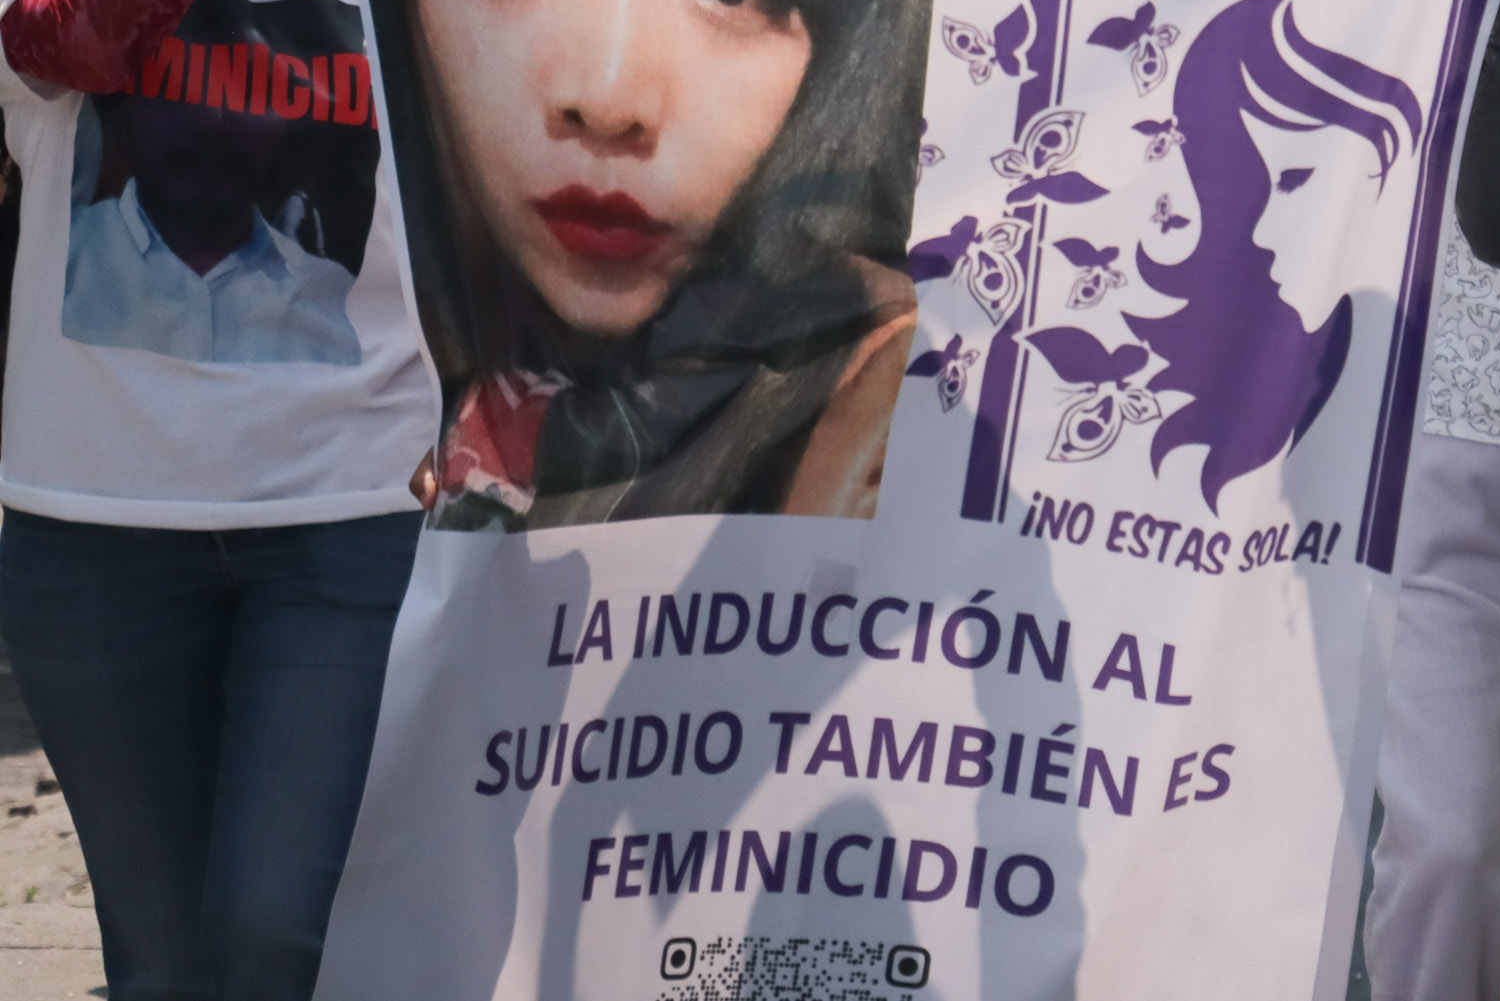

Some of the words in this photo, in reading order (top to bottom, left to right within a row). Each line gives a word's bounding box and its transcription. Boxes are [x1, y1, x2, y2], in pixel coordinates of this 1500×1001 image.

[122, 36, 378, 130] MINICID
[1020, 491, 1095, 545] ¡NO
[1105, 510, 1231, 575] ESTAS
[1238, 520, 1342, 572] SOLA!
[547, 599, 613, 668] LA
[633, 589, 1071, 683] INDUCCIÓN
[1091, 632, 1193, 706] AL
[475, 710, 743, 796] SUICIDIO
[769, 711, 1139, 817] TAMBIÉN
[1162, 743, 1236, 813] ES
[582, 830, 1055, 917] FEMINICIDIO
